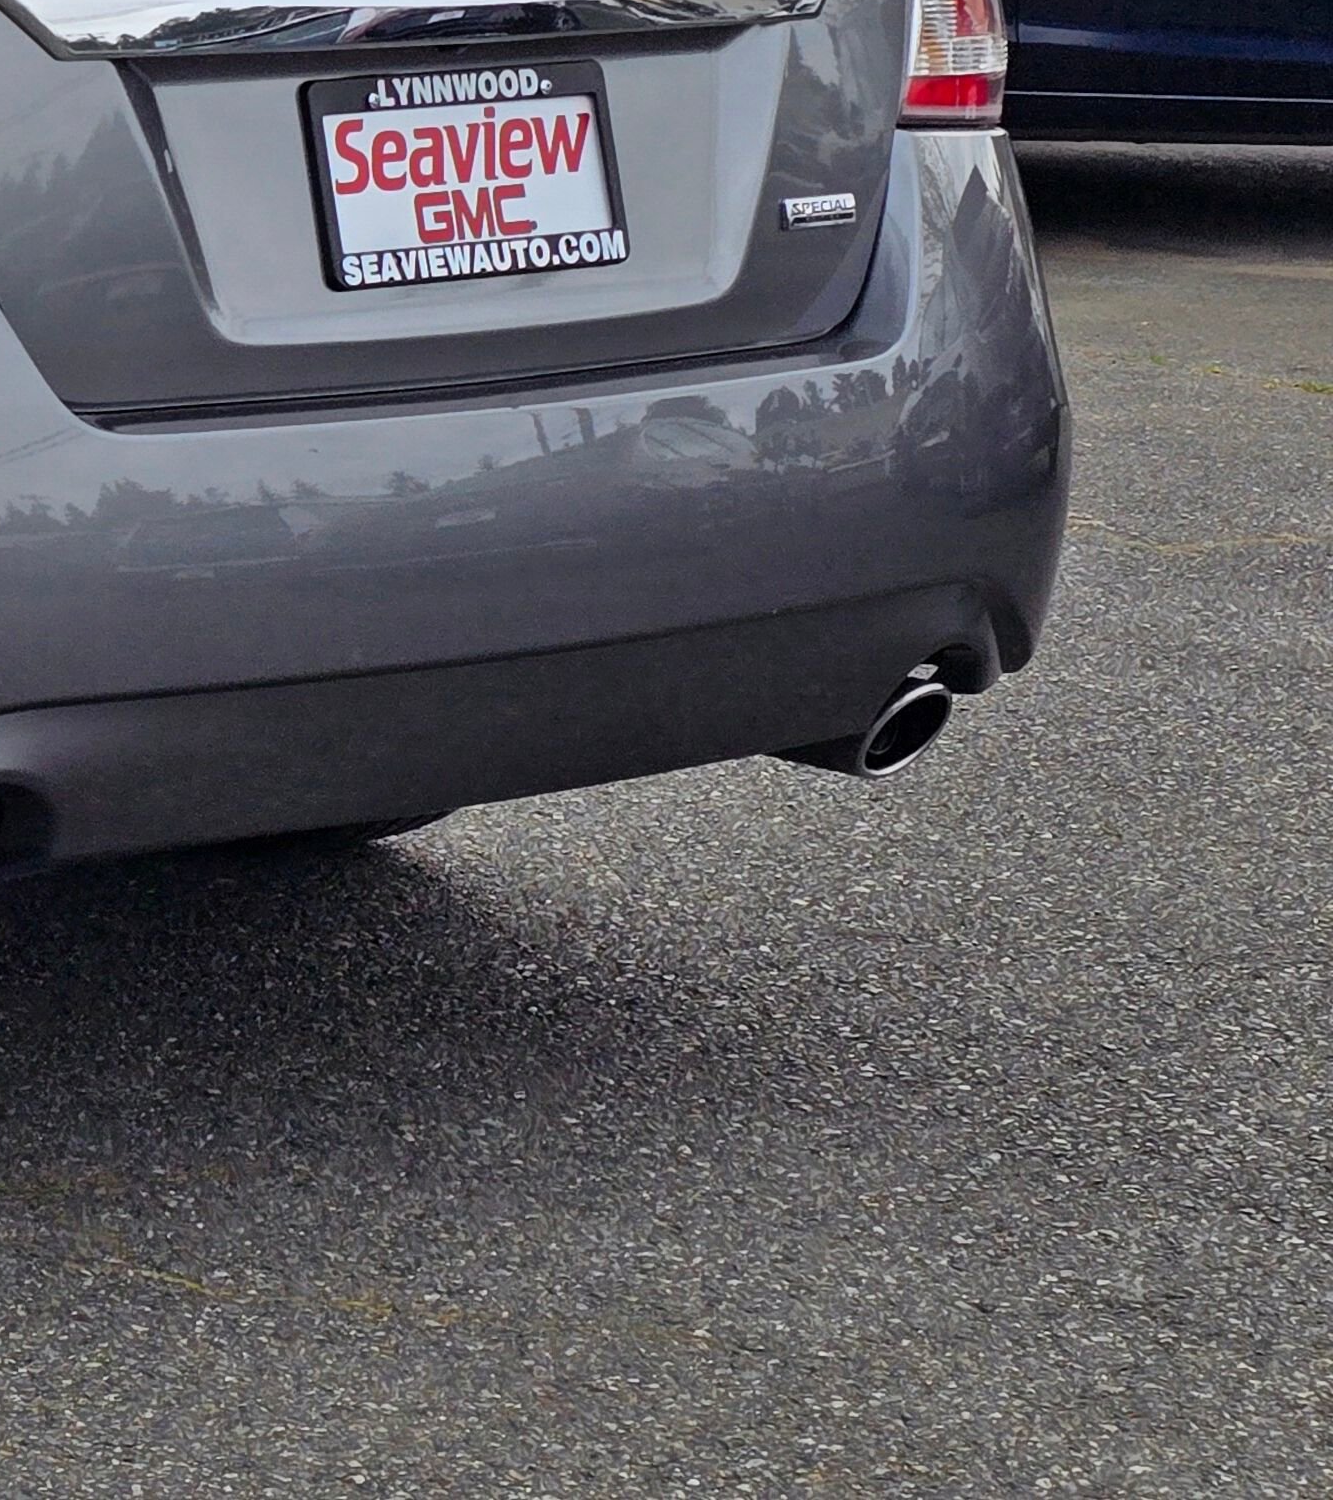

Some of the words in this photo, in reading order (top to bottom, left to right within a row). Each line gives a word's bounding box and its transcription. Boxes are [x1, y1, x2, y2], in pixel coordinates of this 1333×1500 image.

[376, 69, 539, 107] LYNNWOOD
[334, 106, 590, 194] Seaview
[414, 184, 537, 244] GMC
[791, 200, 849, 216] SPECIAL
[341, 230, 627, 286] SEAVIEWAUTO.COM
